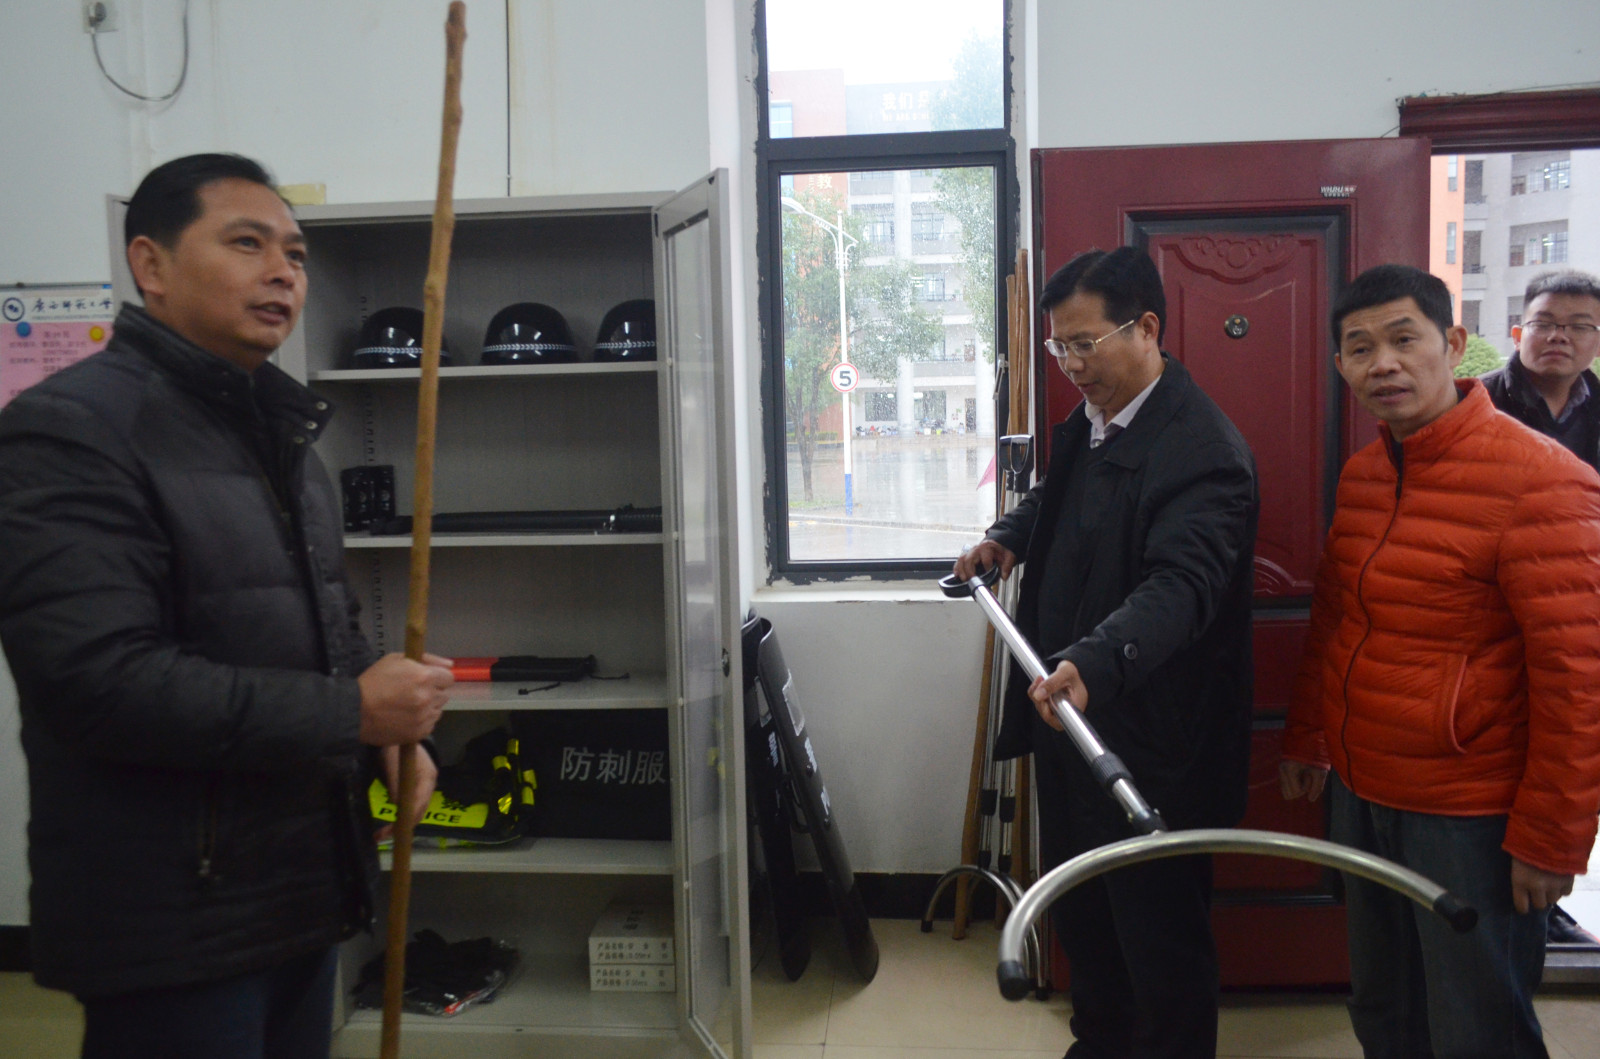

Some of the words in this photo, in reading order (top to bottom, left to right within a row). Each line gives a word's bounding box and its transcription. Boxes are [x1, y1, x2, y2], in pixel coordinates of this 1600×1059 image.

[839, 370, 852, 387] 5
[560, 746, 667, 785] 防刺服
[378, 807, 462, 824] PICE
